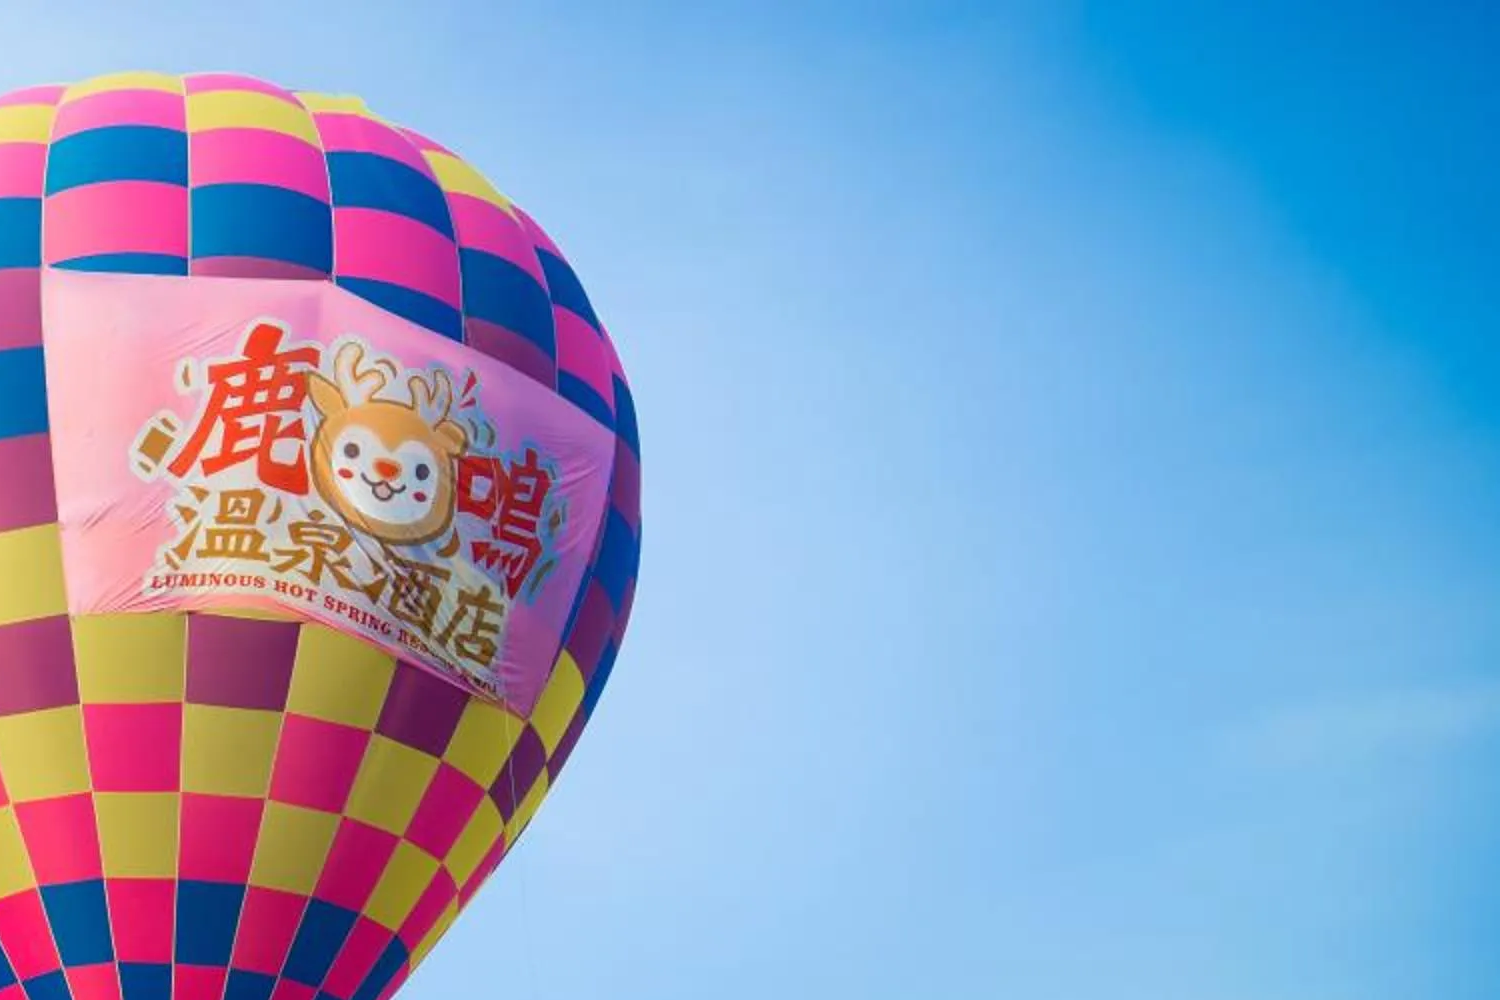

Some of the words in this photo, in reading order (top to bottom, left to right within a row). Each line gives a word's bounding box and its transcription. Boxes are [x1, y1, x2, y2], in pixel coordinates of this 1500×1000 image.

[151, 573, 267, 590] LUMINOUS
[274, 579, 318, 602] HOT
[323, 595, 392, 635] SPRING
